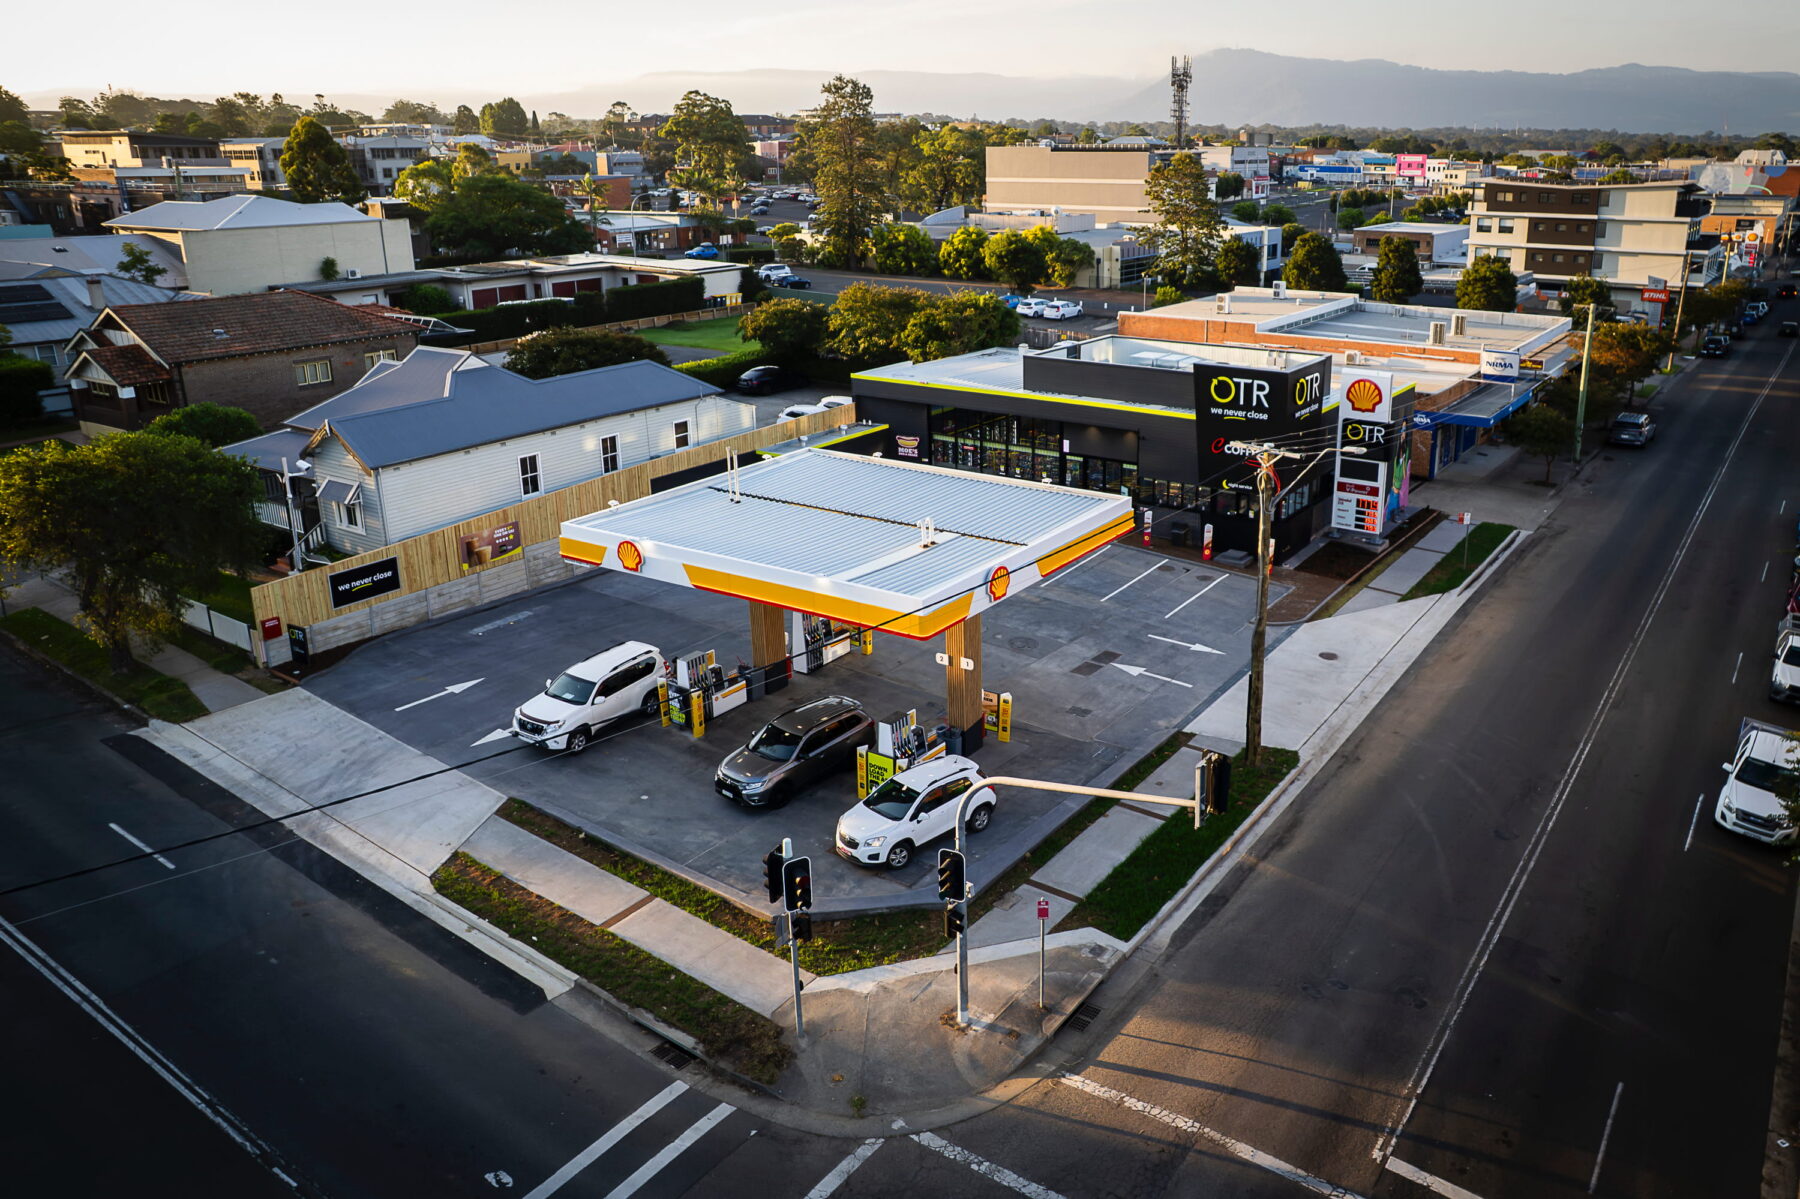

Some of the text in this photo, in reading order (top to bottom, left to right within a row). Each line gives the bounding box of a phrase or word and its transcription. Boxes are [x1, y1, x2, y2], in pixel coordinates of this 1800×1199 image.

[1486, 361, 1513, 369] NRMA
[1210, 376, 1270, 408] OTR
[1295, 372, 1320, 405] OTR
[1310, 403, 1319, 411] close
[1223, 409, 1246, 417] never
[1247, 412, 1268, 420] close
[1347, 424, 1385, 444] OTR
[338, 571, 392, 591] we never close
[290, 629, 304, 641] OTR
[869, 763, 888, 773] DOWN
